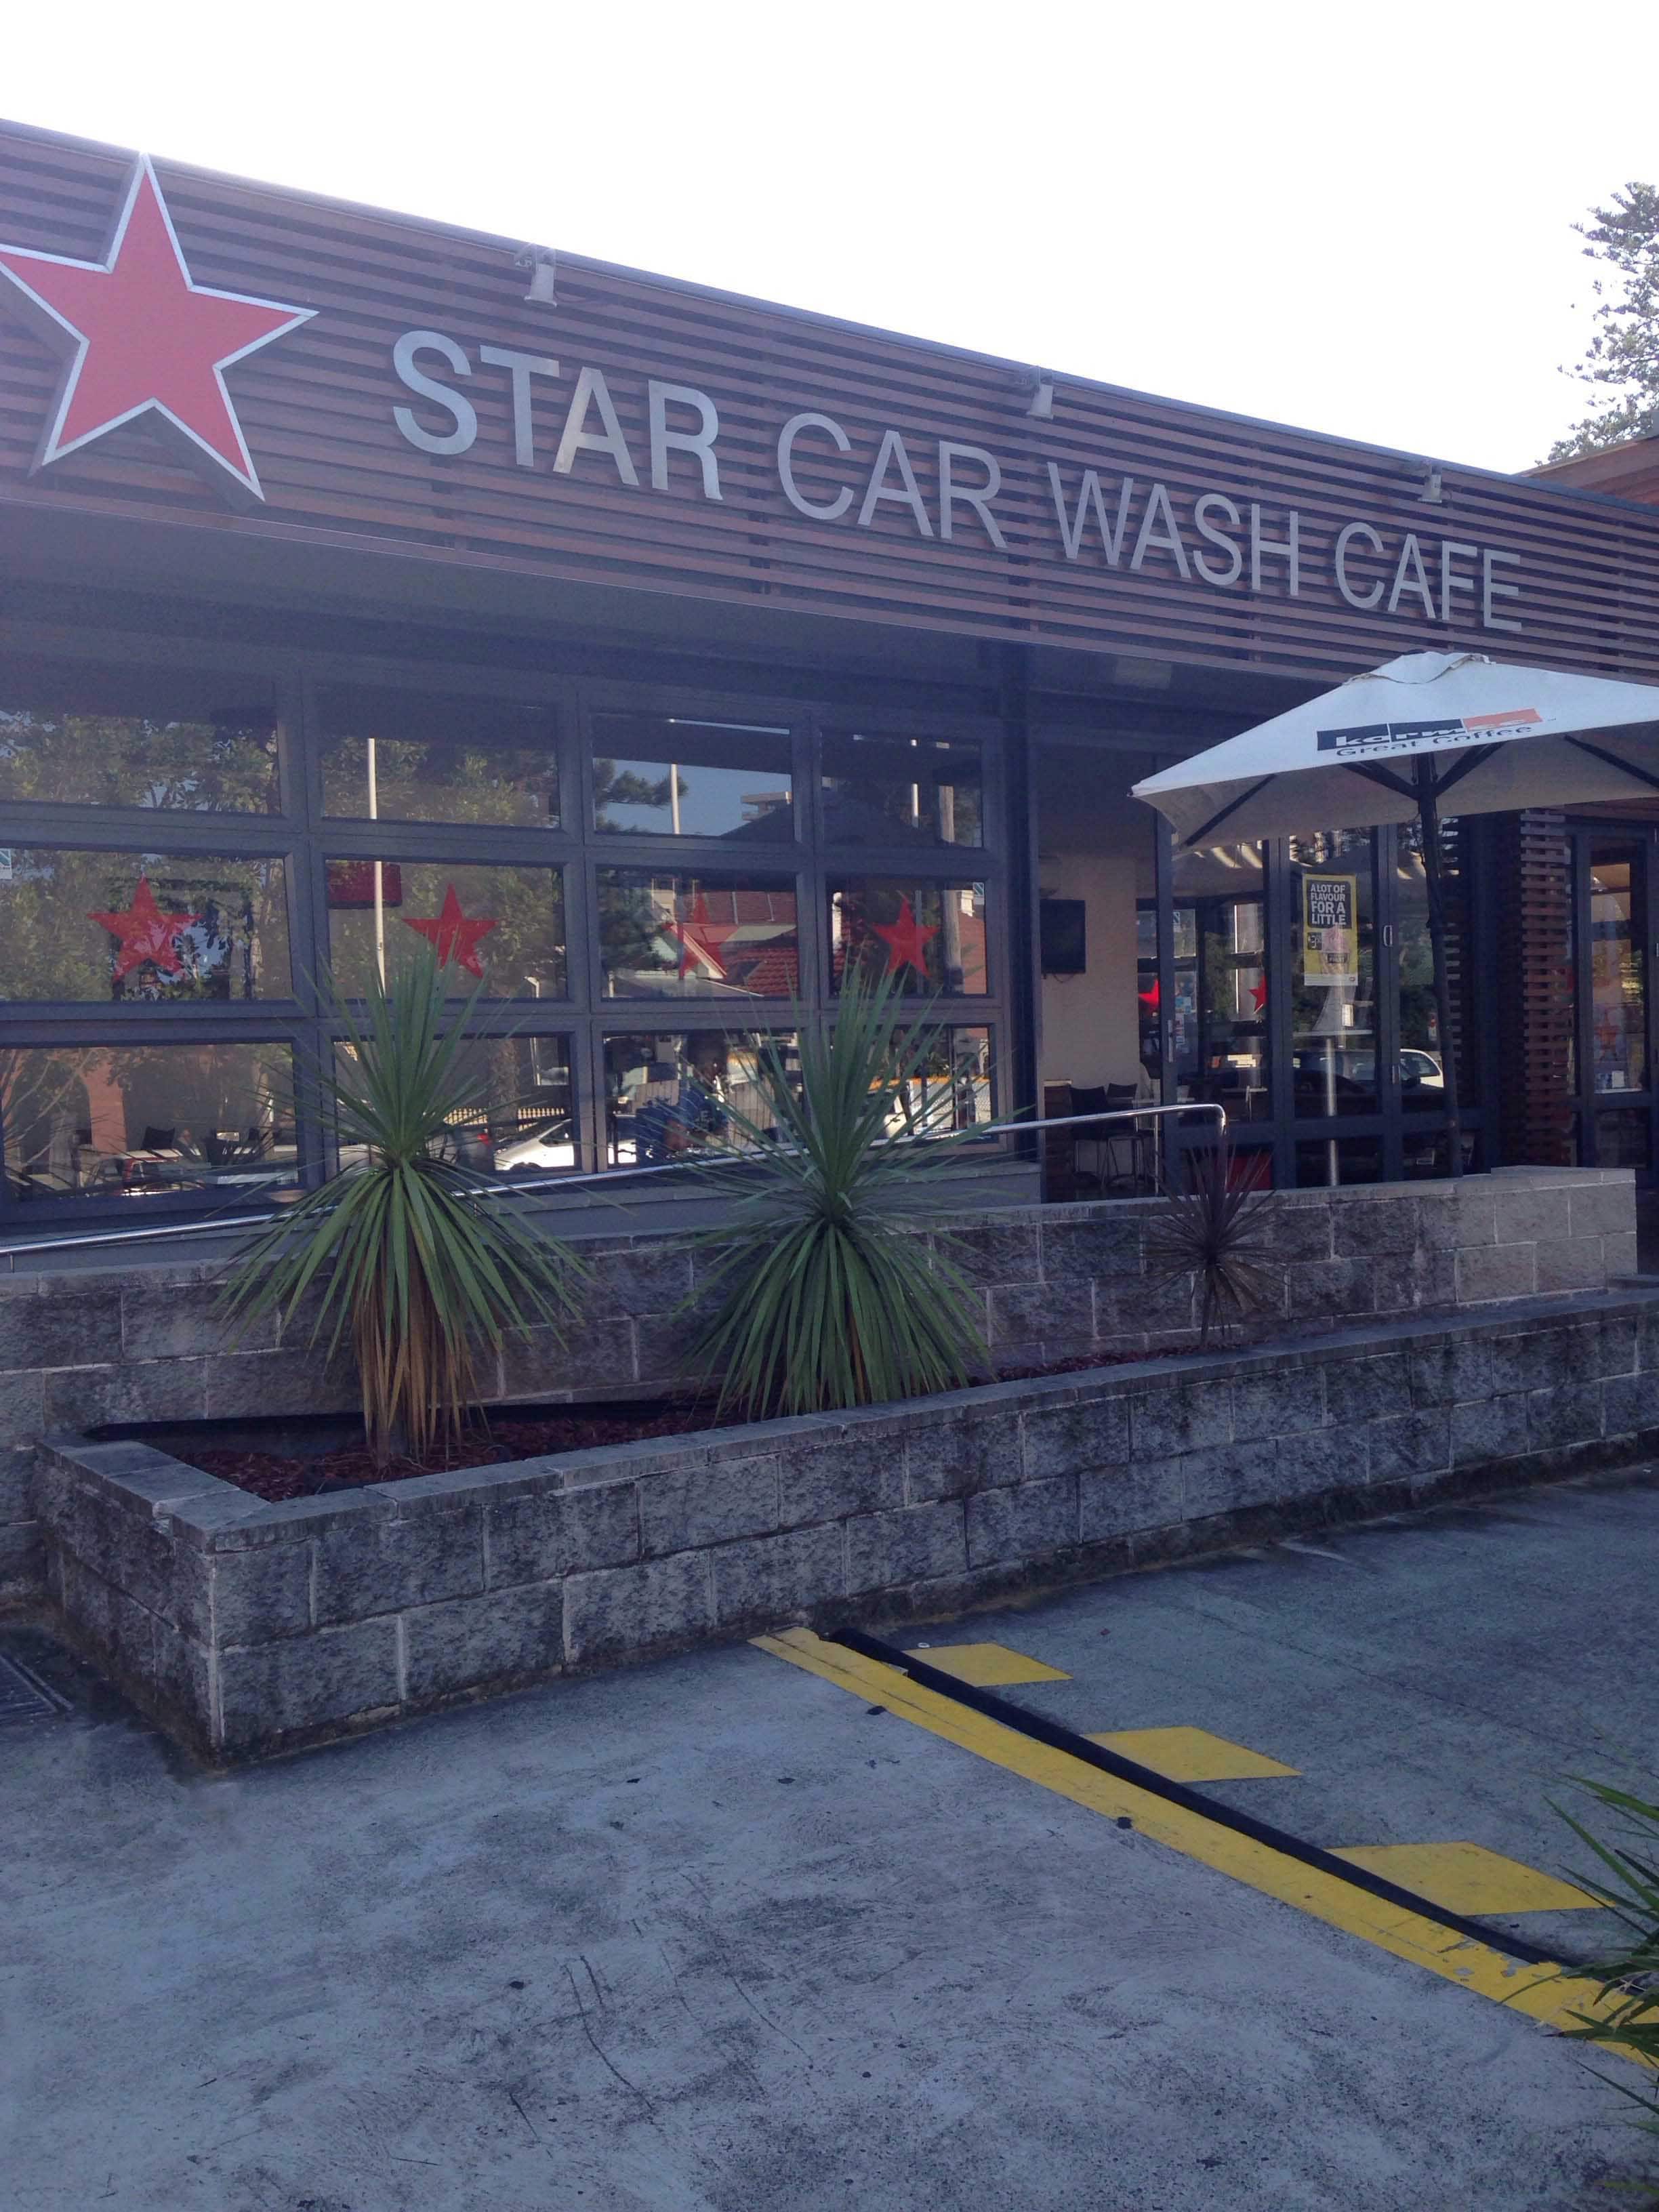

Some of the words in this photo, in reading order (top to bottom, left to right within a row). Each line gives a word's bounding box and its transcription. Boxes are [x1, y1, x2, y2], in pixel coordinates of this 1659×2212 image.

[393, 330, 723, 501] STAR
[777, 413, 1008, 549] CAR
[1047, 462, 1299, 596] WASH
[1335, 521, 1522, 632] CAFE
[1336, 739, 1418, 756] Great
[1433, 726, 1532, 744] Coffee
[1311, 883, 1316, 892] A
[1317, 884, 1332, 893] LOT
[1333, 884, 1346, 893] OF
[1311, 892, 1346, 902] FLAVOUR
[1311, 901, 1334, 914] FOR
[1336, 902, 1345, 914] A
[1311, 913, 1347, 926] LITTLE
